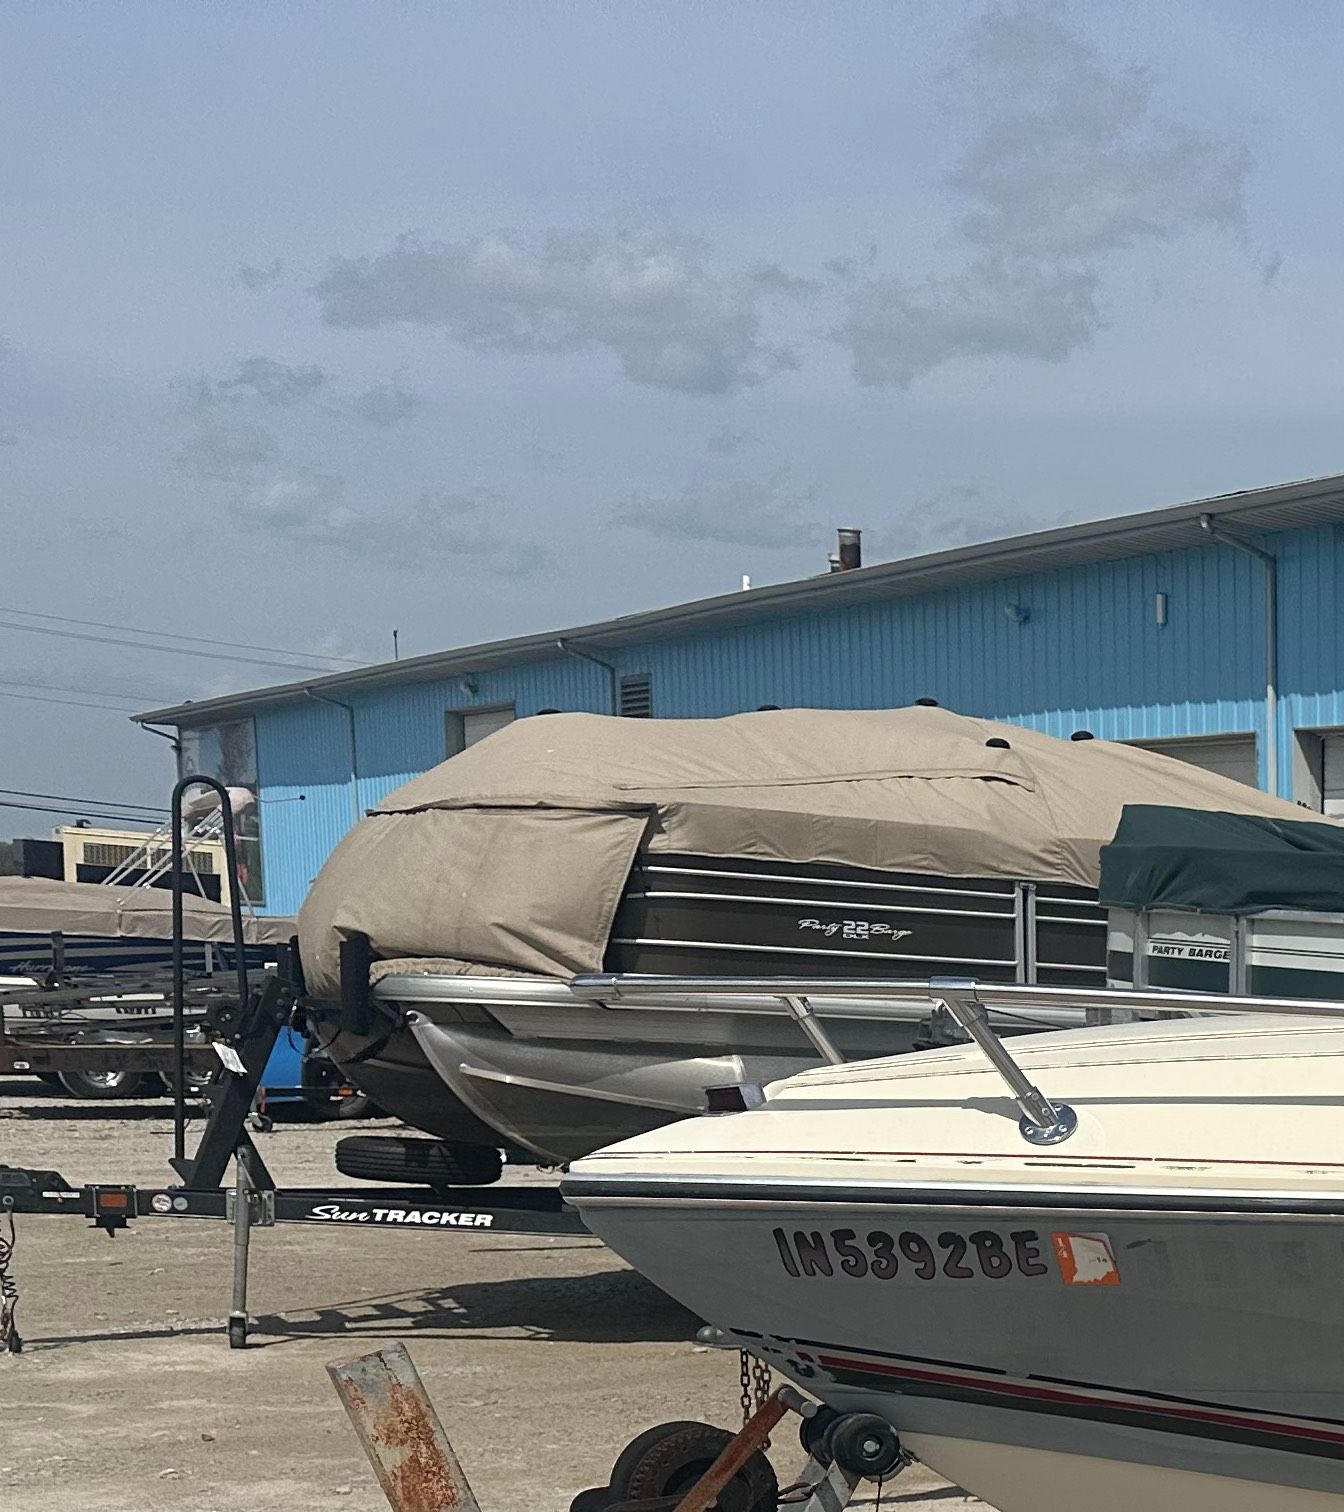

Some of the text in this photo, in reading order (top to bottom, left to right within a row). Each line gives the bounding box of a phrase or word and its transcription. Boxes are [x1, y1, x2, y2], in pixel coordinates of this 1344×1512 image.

[797, 918, 913, 941] Party 22 Barge
[1152, 944, 1232, 960] PARTY BARGE
[304, 1204, 494, 1227] Sun TRACKER
